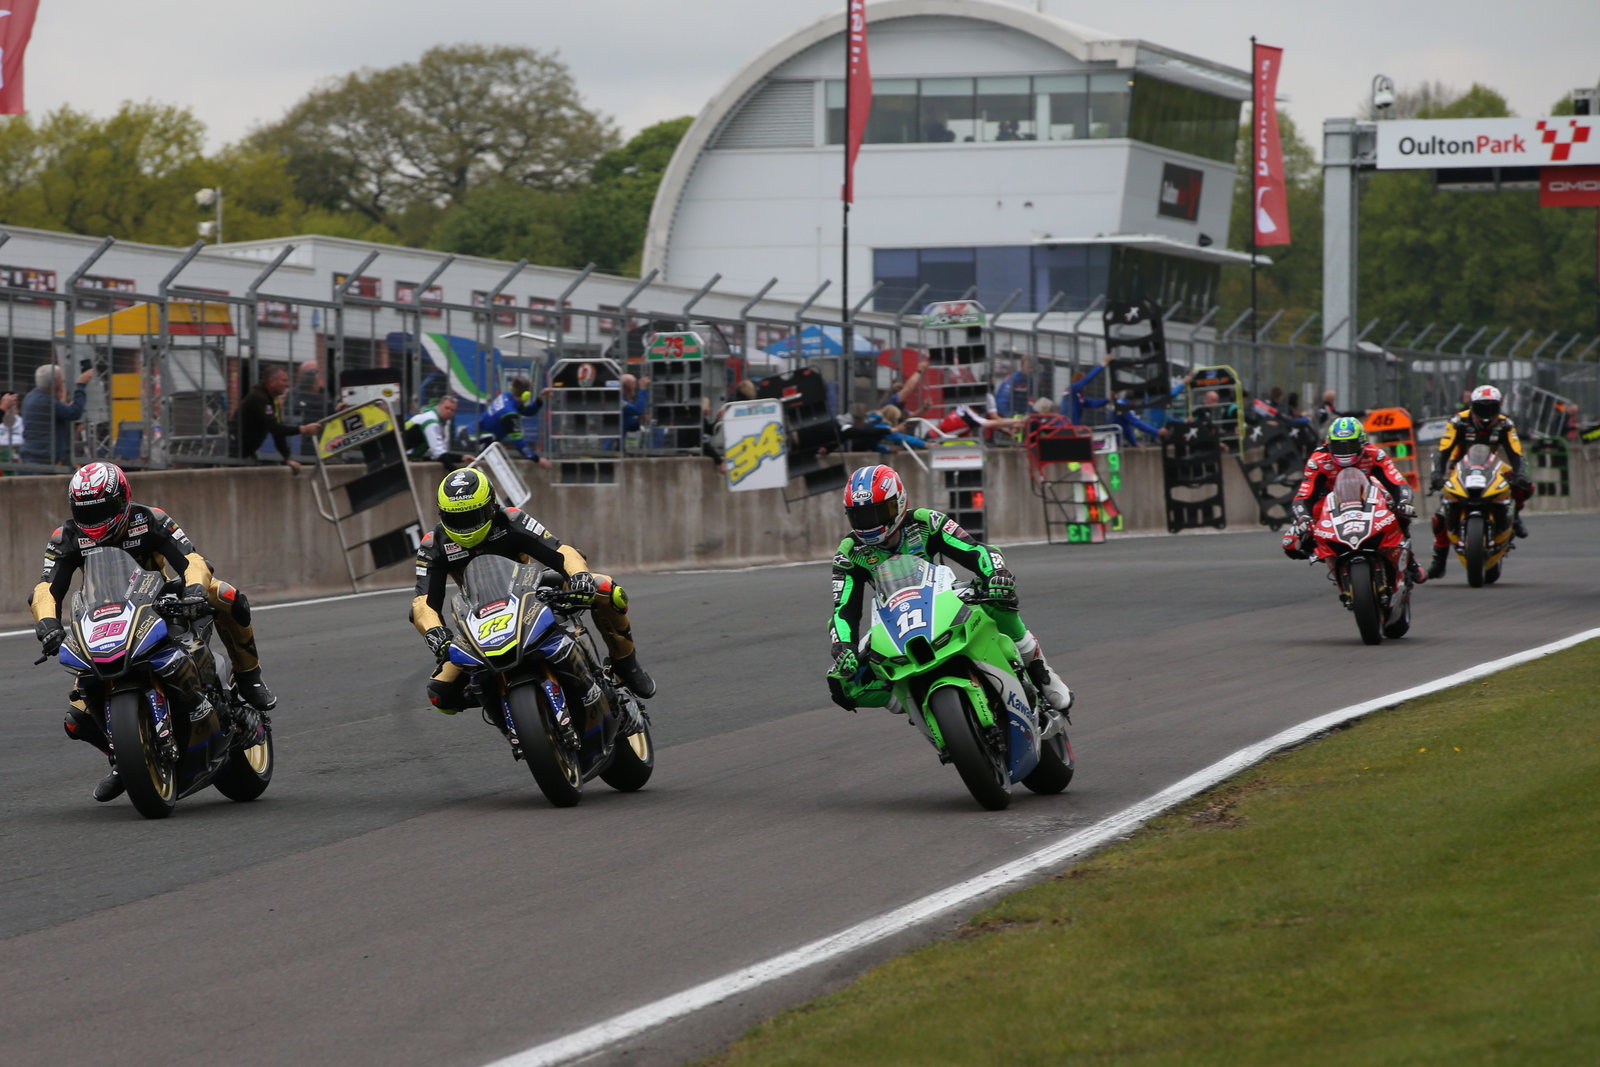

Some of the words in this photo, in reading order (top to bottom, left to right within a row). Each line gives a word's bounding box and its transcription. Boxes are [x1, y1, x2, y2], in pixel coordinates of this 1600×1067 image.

[1399, 134, 1526, 155] OultonPark
[1372, 413, 1395, 426] 46
[724, 421, 785, 486] 34
[75, 488, 99, 497] SHARK
[852, 490, 872, 500] Arai
[1342, 521, 1366, 536] 25
[88, 620, 127, 643] 28
[478, 613, 514, 640] 77
[896, 609, 928, 639] 11
